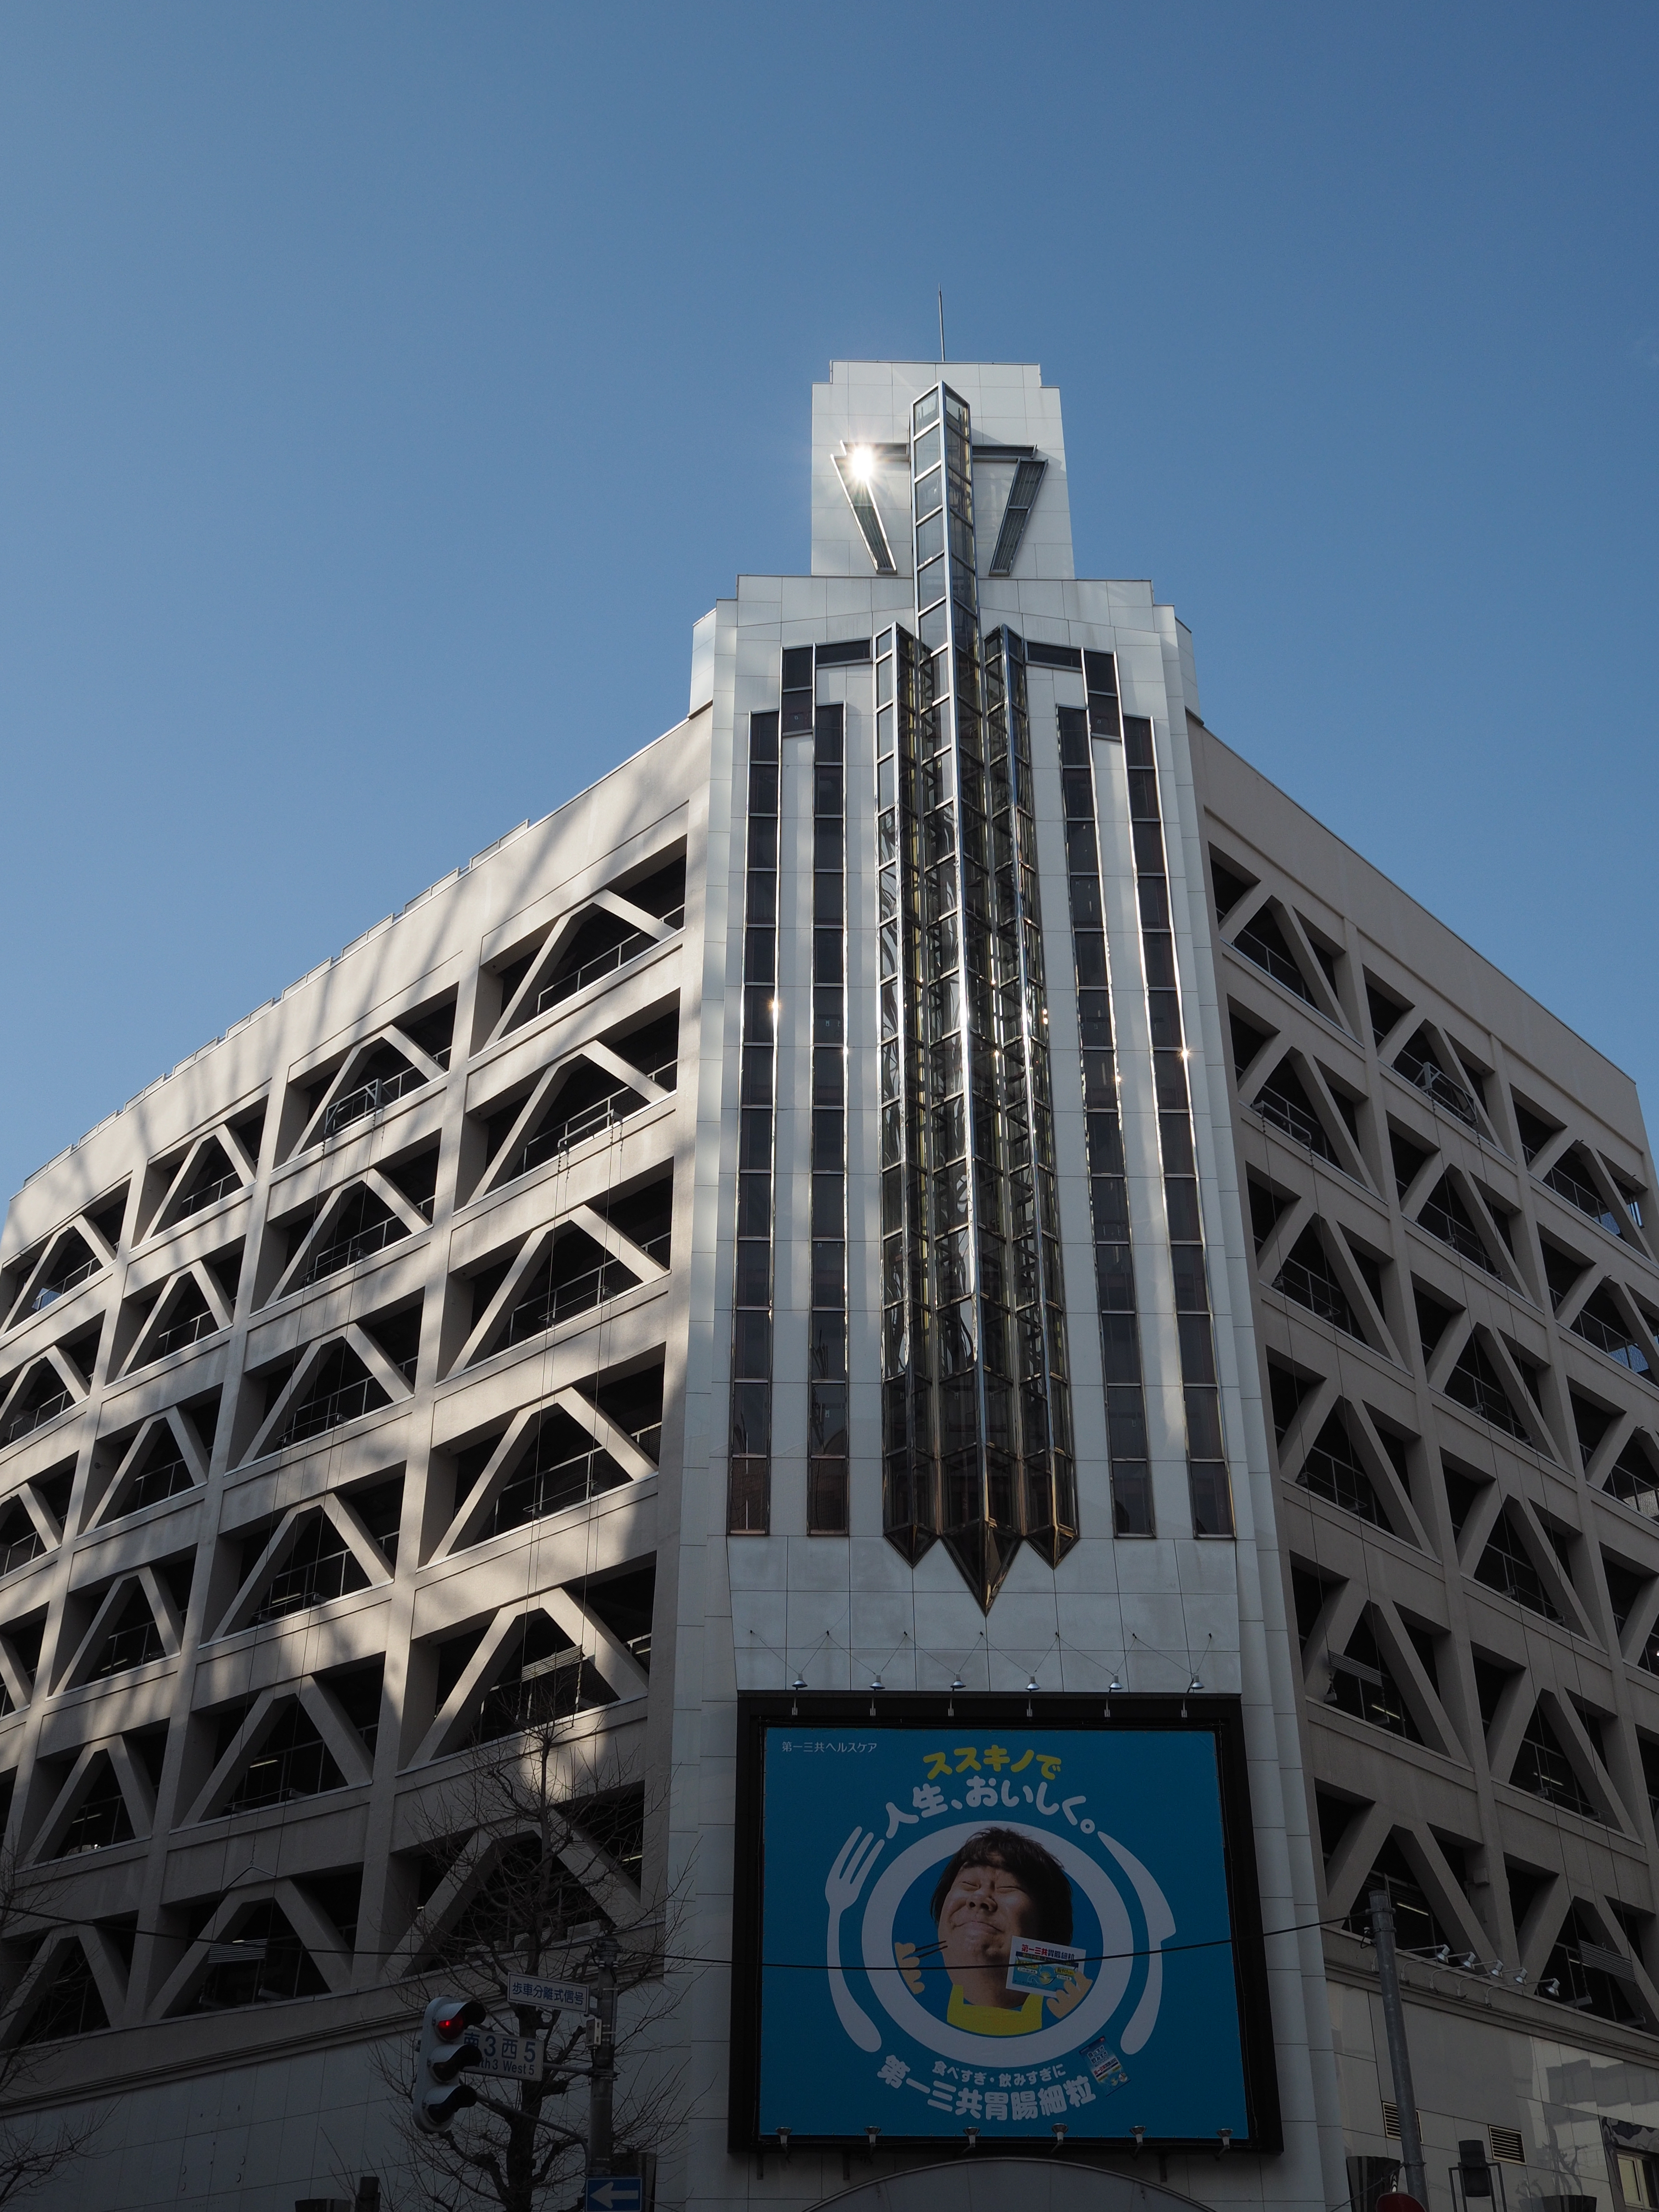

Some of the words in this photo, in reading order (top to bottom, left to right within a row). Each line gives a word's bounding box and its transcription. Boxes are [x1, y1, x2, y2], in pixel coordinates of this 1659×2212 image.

[781, 1741, 878, 1753] 第一三共ヘルスケア
[923, 1744, 1062, 1780] ススキノで
[885, 1775, 1095, 1839] 人生、おいしく。
[512, 1982, 584, 2006] 歩車分離式信号
[503, 2060, 526, 2074] West
[932, 2060, 1066, 2087] 食べすぎ・飲みすぎに
[877, 2055, 1096, 2121] 第一三共胃腸細粒
